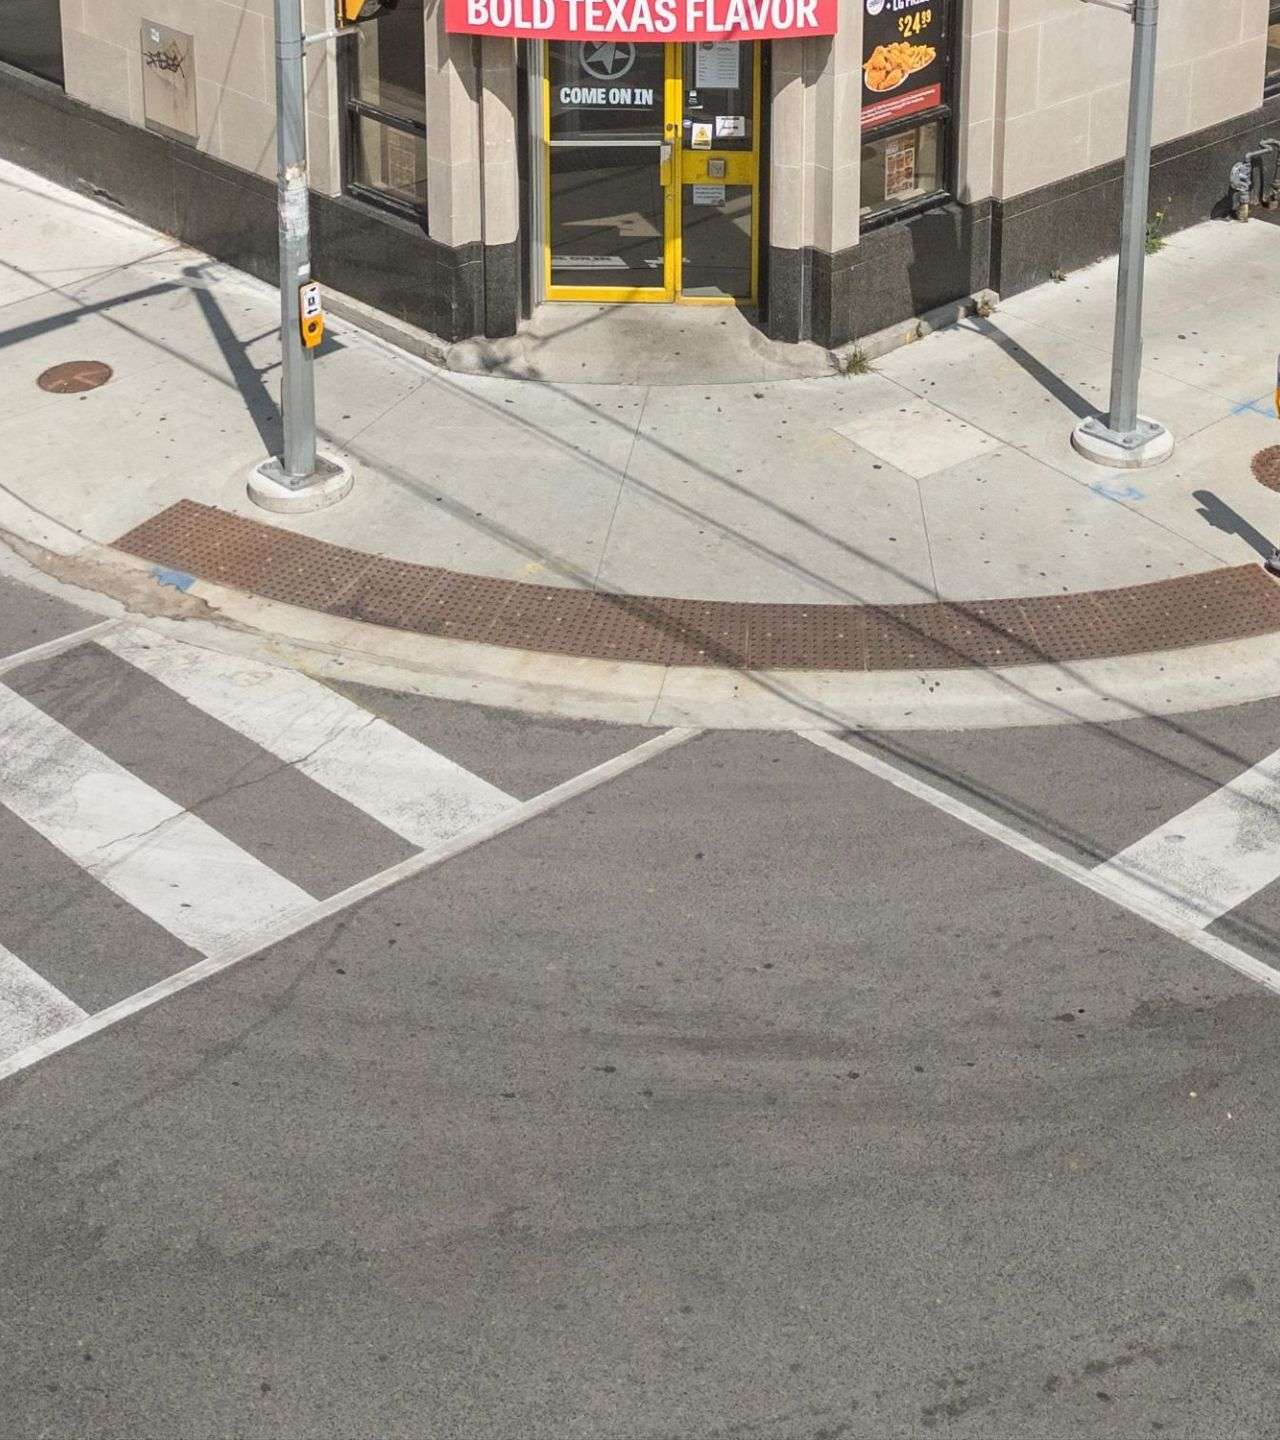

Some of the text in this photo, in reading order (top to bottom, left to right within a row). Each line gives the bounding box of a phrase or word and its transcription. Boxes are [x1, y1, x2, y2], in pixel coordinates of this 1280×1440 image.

[559, 87, 653, 105] COME ON IN
